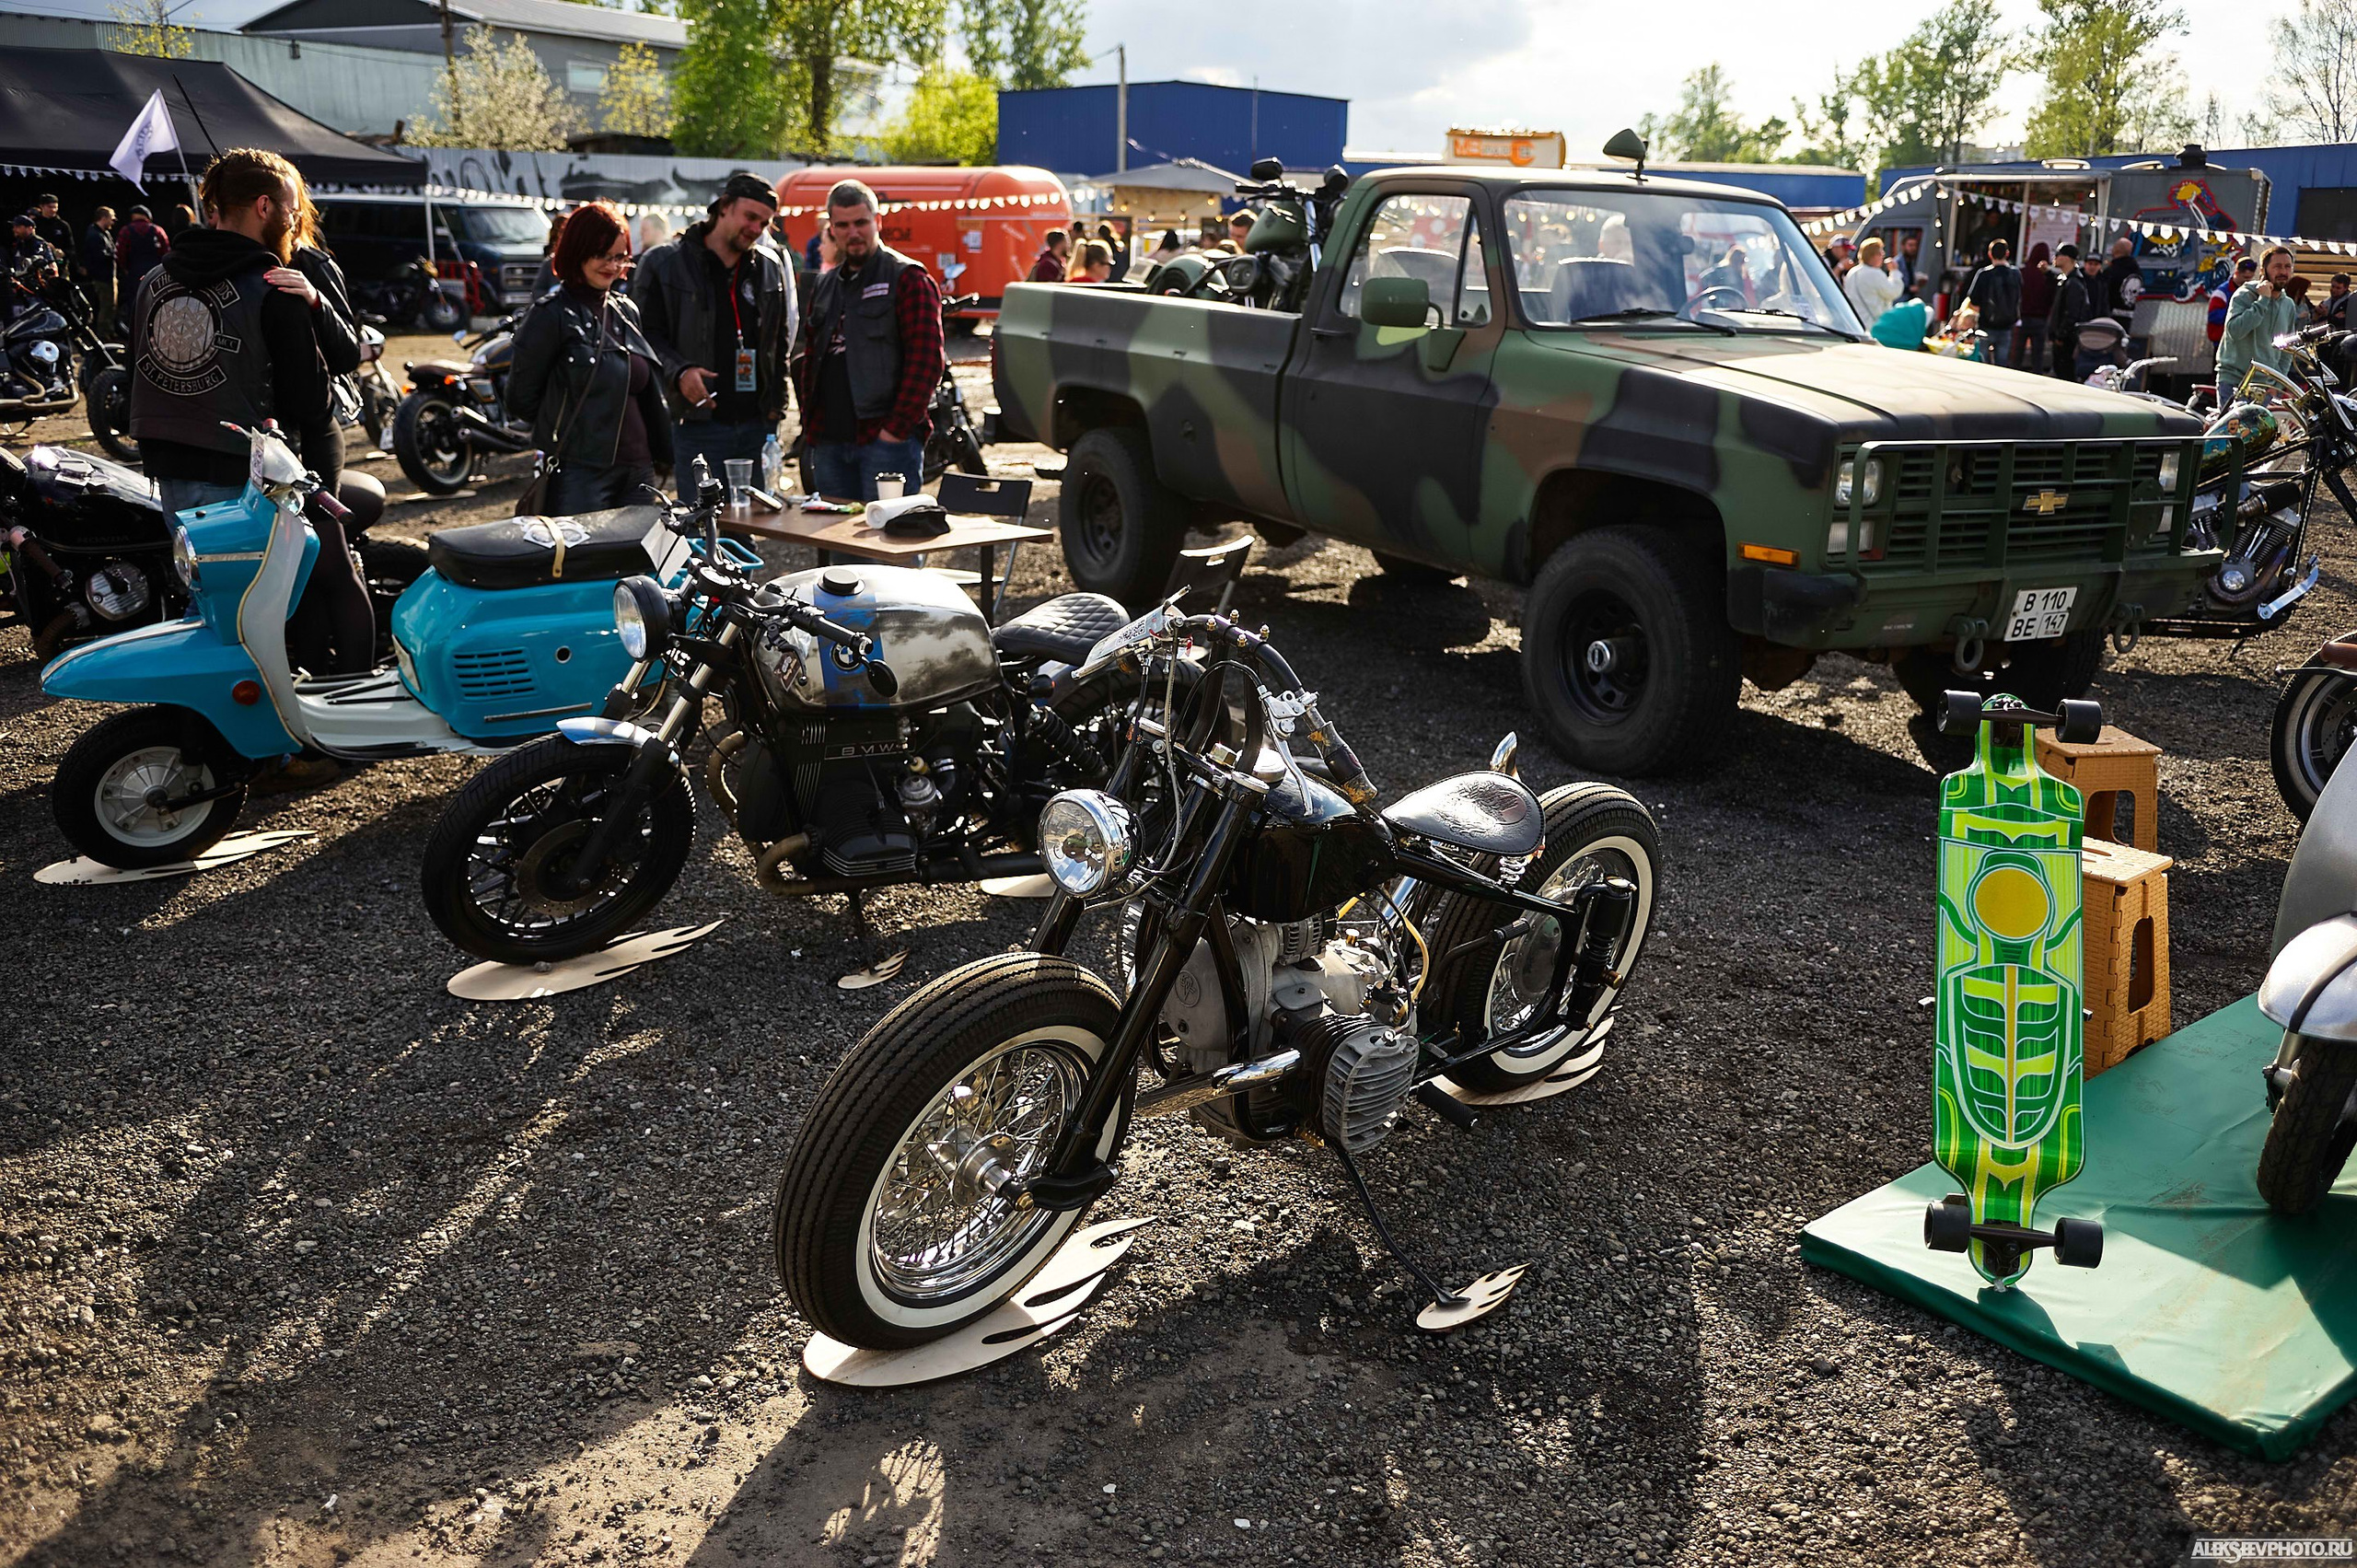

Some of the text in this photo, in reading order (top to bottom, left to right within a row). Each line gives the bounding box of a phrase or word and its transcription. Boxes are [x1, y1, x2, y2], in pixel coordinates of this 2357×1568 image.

[217, 337, 237, 349] MCC
[143, 362, 219, 392] ST. PETERSBURG
[2024, 591, 2067, 612] B 110
[2012, 614, 2066, 637] BE 147
[842, 743, 894, 756] BMW
